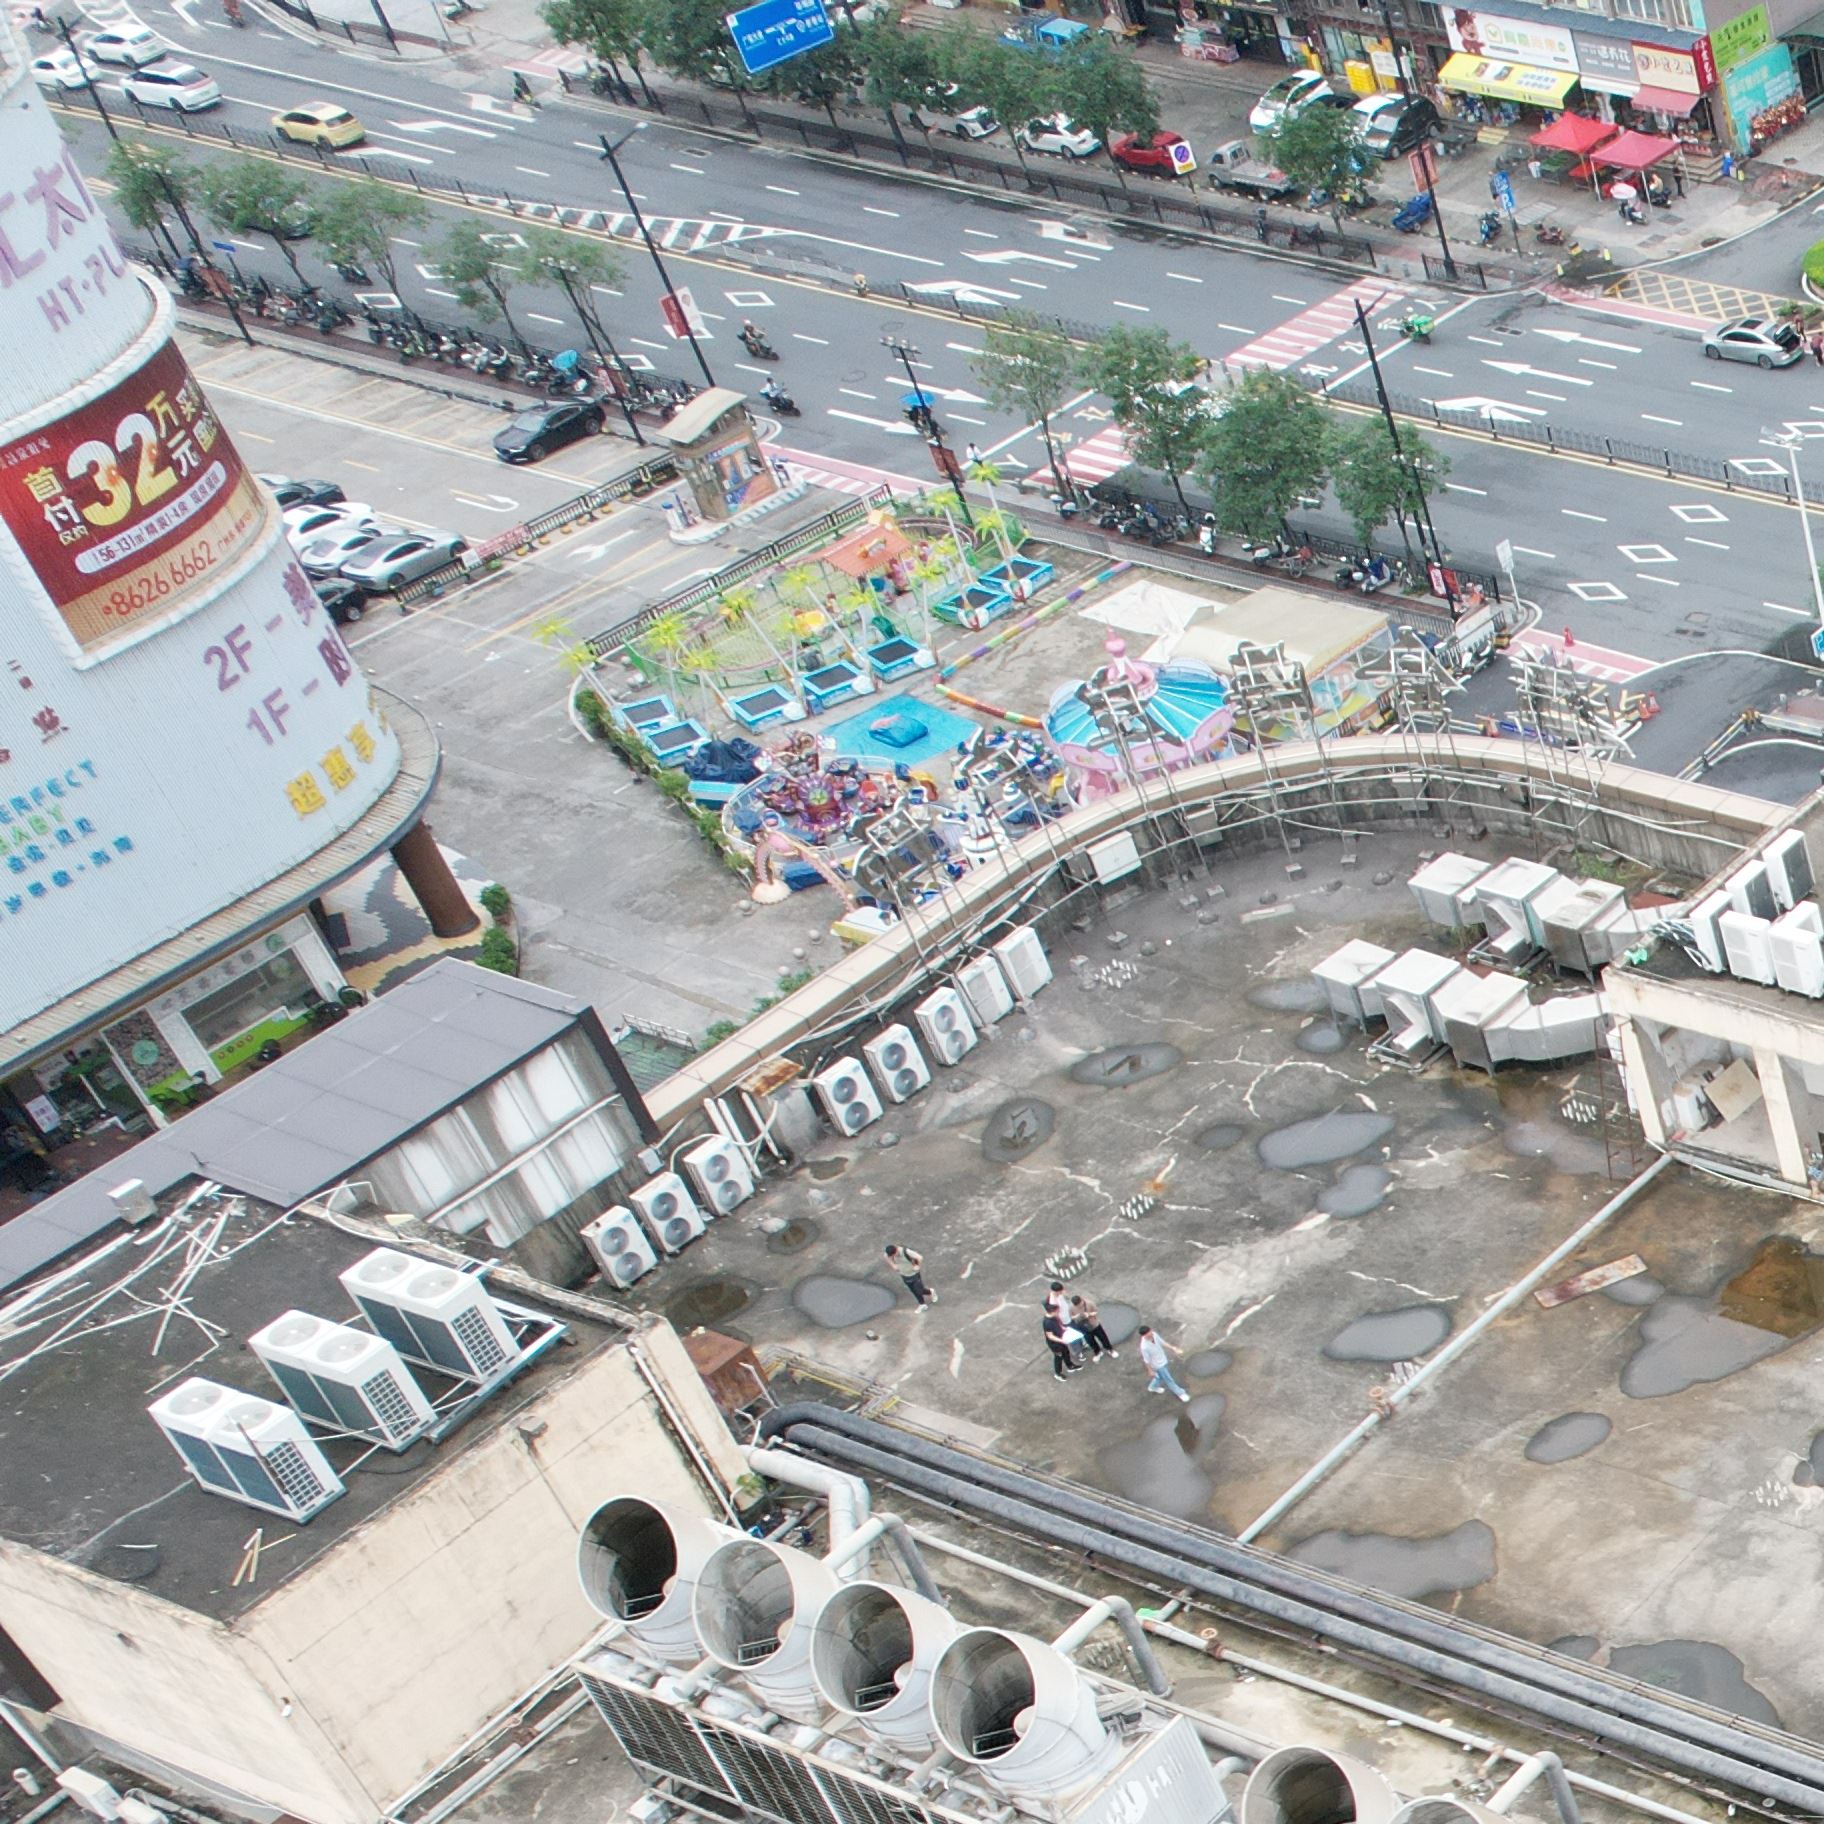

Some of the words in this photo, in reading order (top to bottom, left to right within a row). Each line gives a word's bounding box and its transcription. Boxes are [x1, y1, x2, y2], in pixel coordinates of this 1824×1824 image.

[22, 465, 83, 534] 首付
[66, 411, 180, 528] 32
[109, 569, 170, 618] 8626
[170, 540, 218, 587] 6662
[203, 623, 255, 693] 2F
[246, 686, 292, 746] 1F
